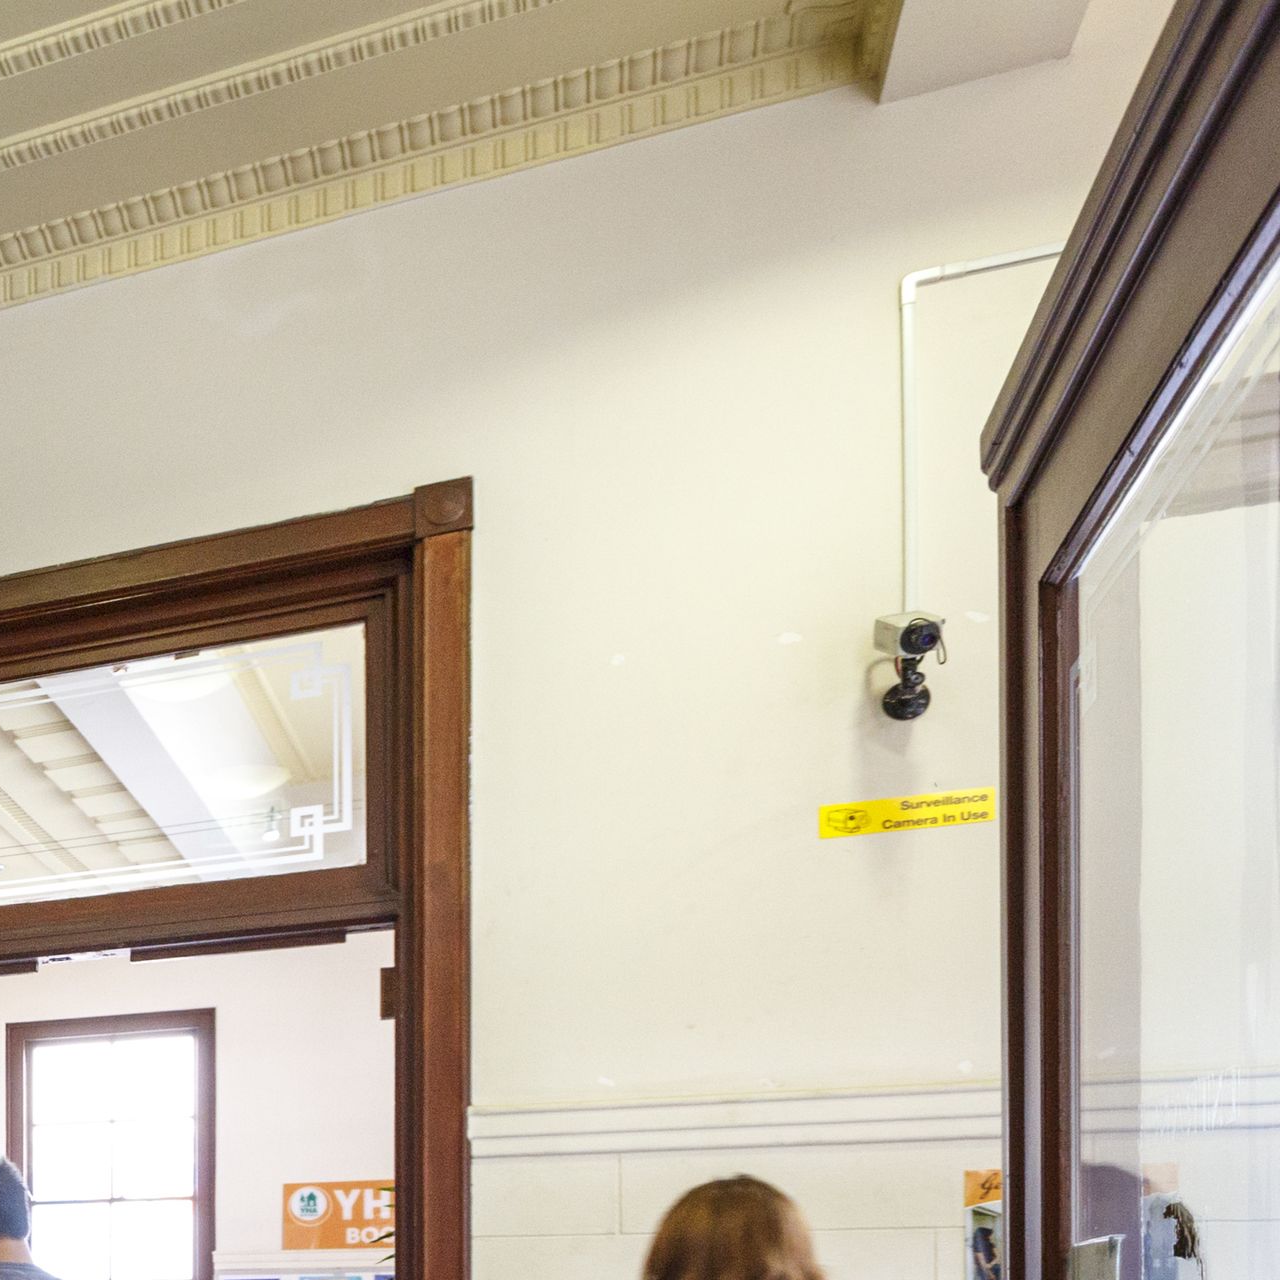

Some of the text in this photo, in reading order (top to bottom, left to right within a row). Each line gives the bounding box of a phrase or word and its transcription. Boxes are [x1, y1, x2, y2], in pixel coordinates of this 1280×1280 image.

[900, 793, 989, 810] Surveillance
[882, 816, 938, 830] Camera
[960, 809, 989, 821] Use
